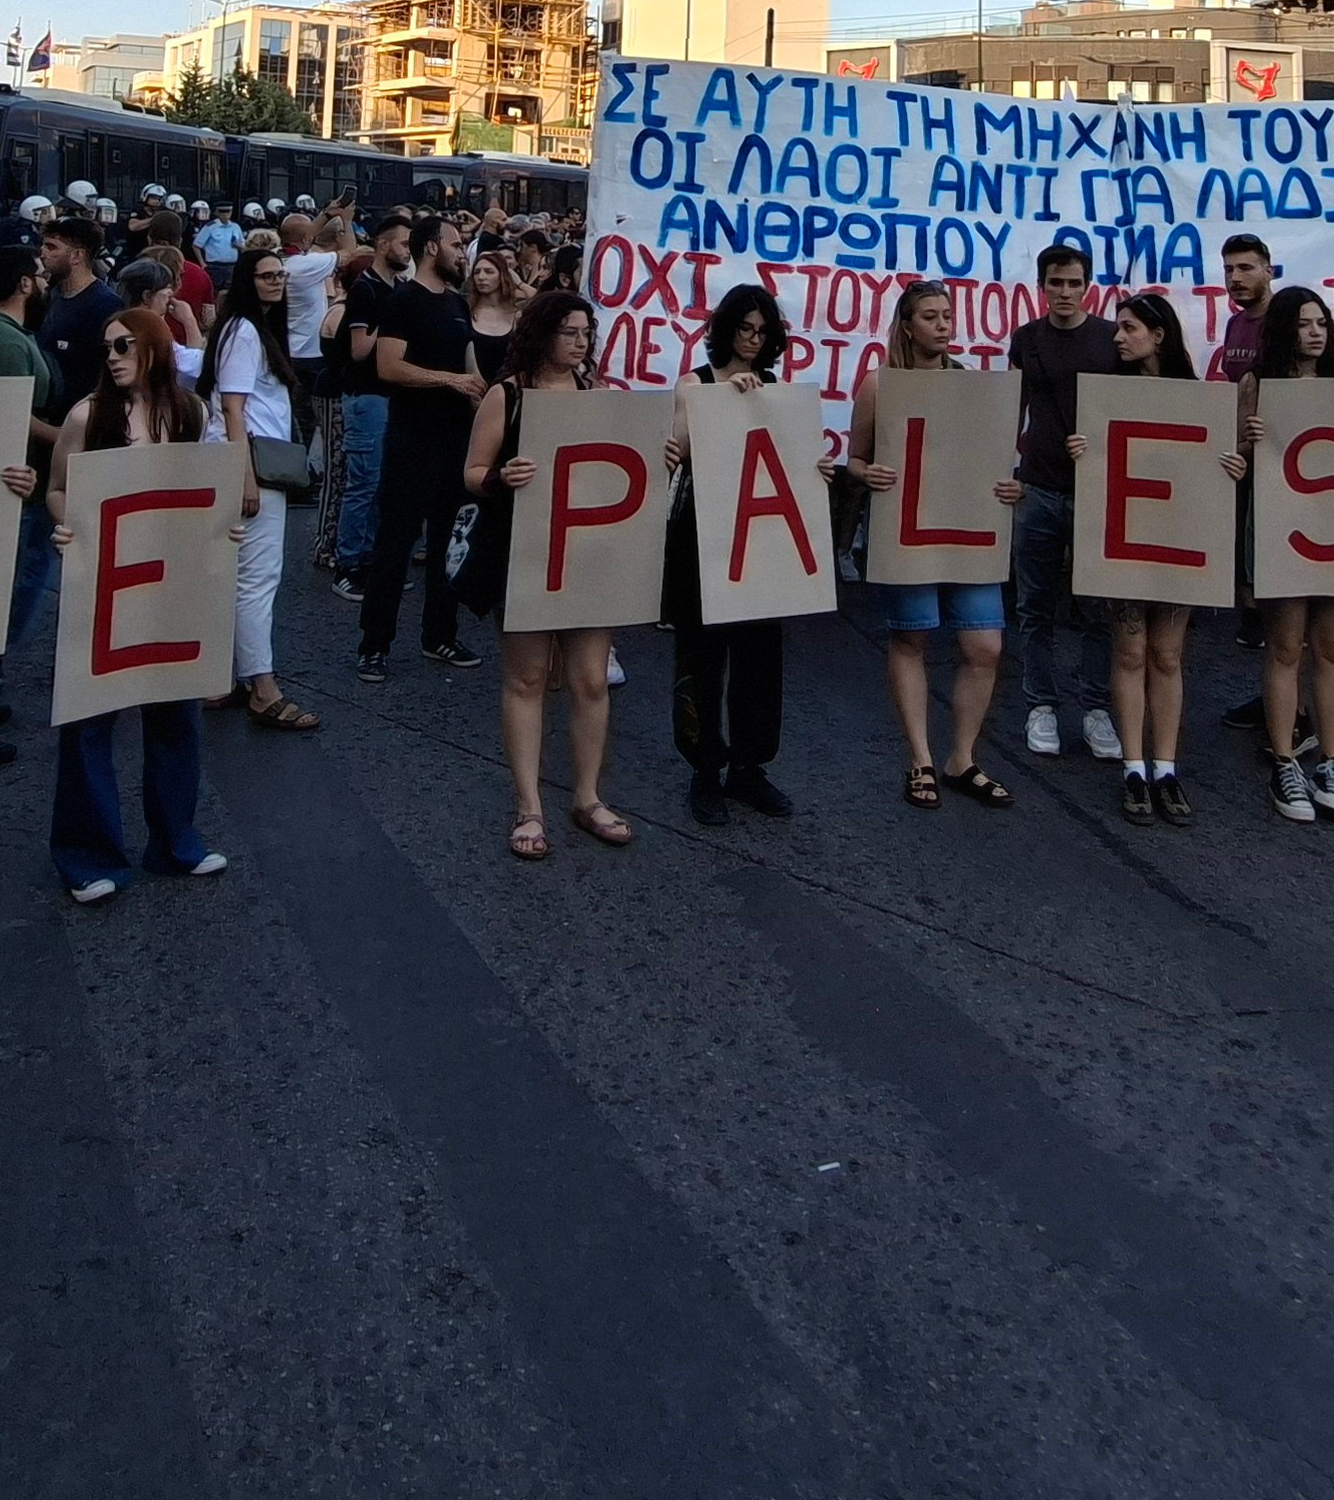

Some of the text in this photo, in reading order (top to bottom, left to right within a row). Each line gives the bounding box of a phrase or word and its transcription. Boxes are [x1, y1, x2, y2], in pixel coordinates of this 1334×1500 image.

[603, 62, 670, 128] ΣΕ
[695, 67, 859, 139] ΑΥΤΗ
[885, 90, 956, 156] ΤΗ
[974, 101, 1207, 164] ΜΗΧΑΝΗ
[1227, 107, 1334, 164] ΤΟΥ
[630, 126, 706, 195] ΟΙ
[727, 133, 902, 209] ΛΑΟΙ
[928, 154, 1061, 222] ΑΝΤΙ
[1080, 165, 1175, 228] ΓΙΑ
[589, 234, 722, 321] ΟΧΙ
[756, 262, 925, 337] ΣΤΟΥ
[656, 194, 1012, 282] ΑΝΘΡΩΠΟΥ
[598, 311, 887, 401] ΛΕΥΡΙΑ
